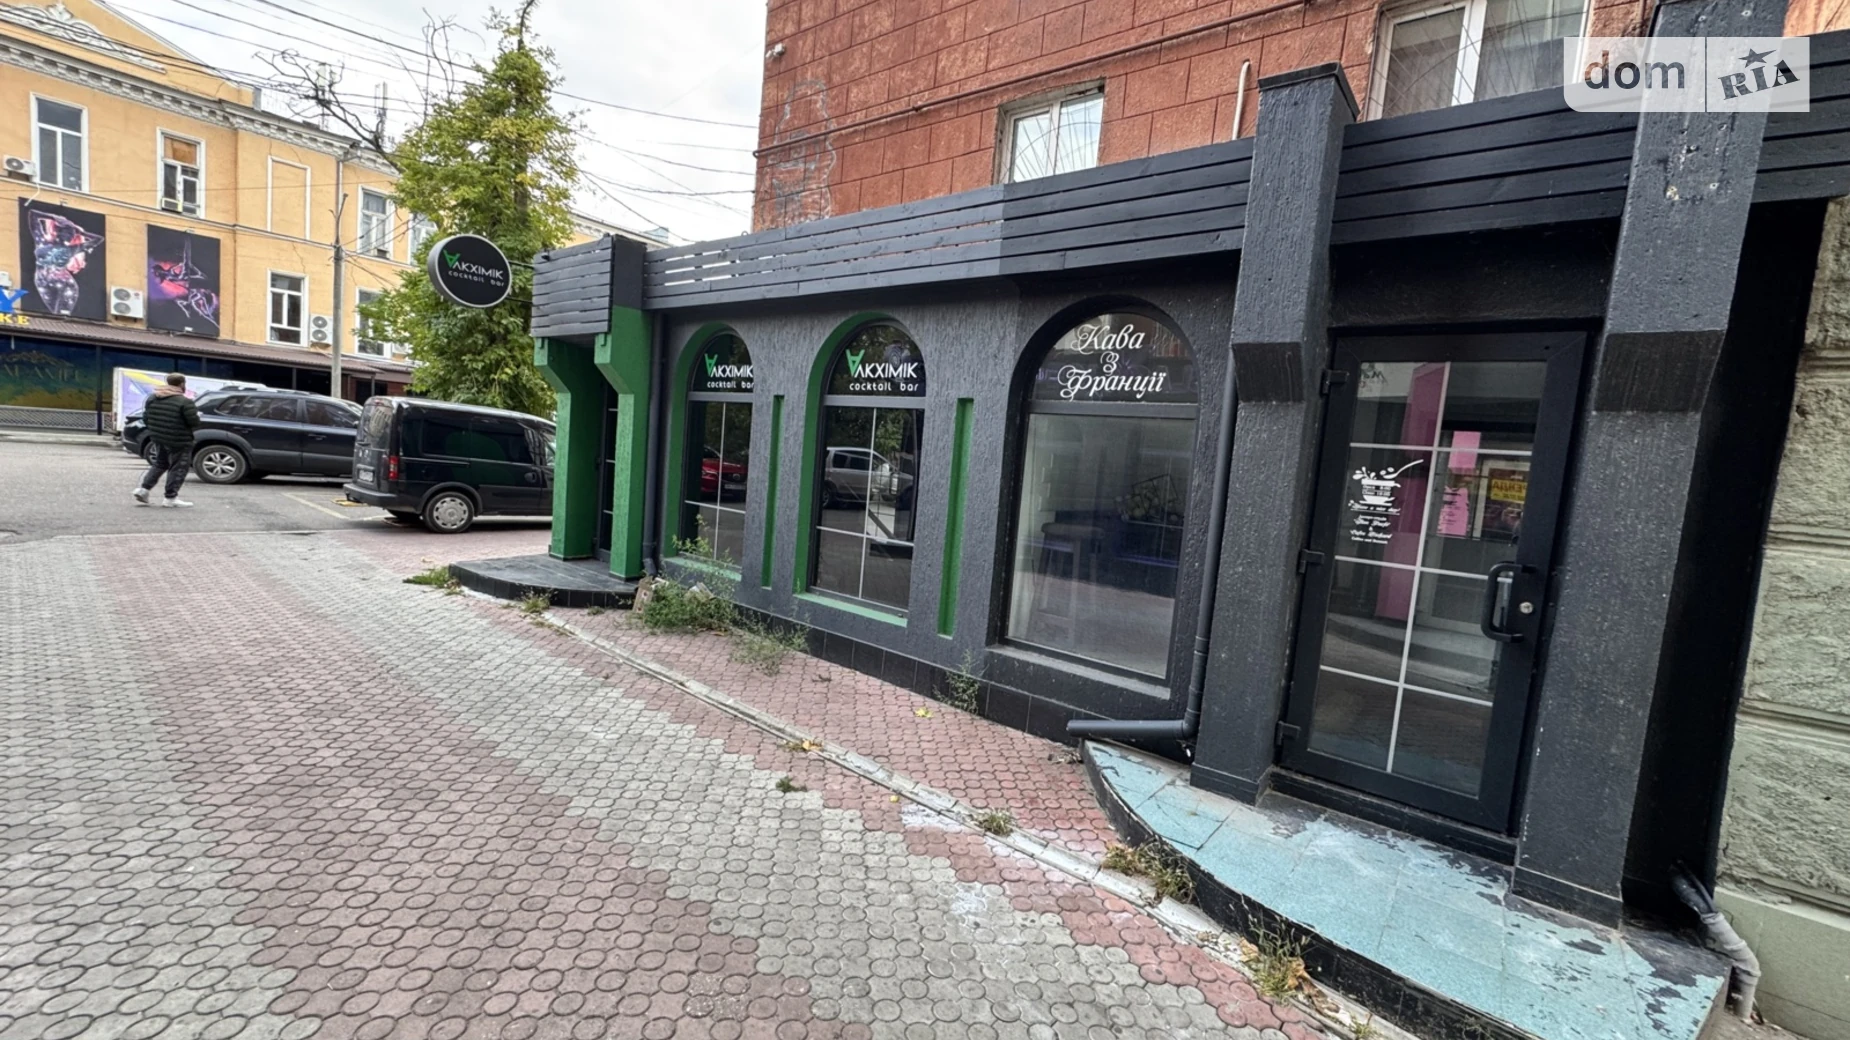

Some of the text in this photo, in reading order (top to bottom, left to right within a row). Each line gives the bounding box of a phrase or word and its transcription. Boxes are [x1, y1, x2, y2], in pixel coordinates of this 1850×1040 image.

[448, 270, 504, 287] cocktail bar
[1071, 324, 1145, 355] Кава
[707, 381, 754, 389] cocktail bar
[849, 381, 919, 391] cocktail bar
[1057, 365, 1167, 402] Франції
